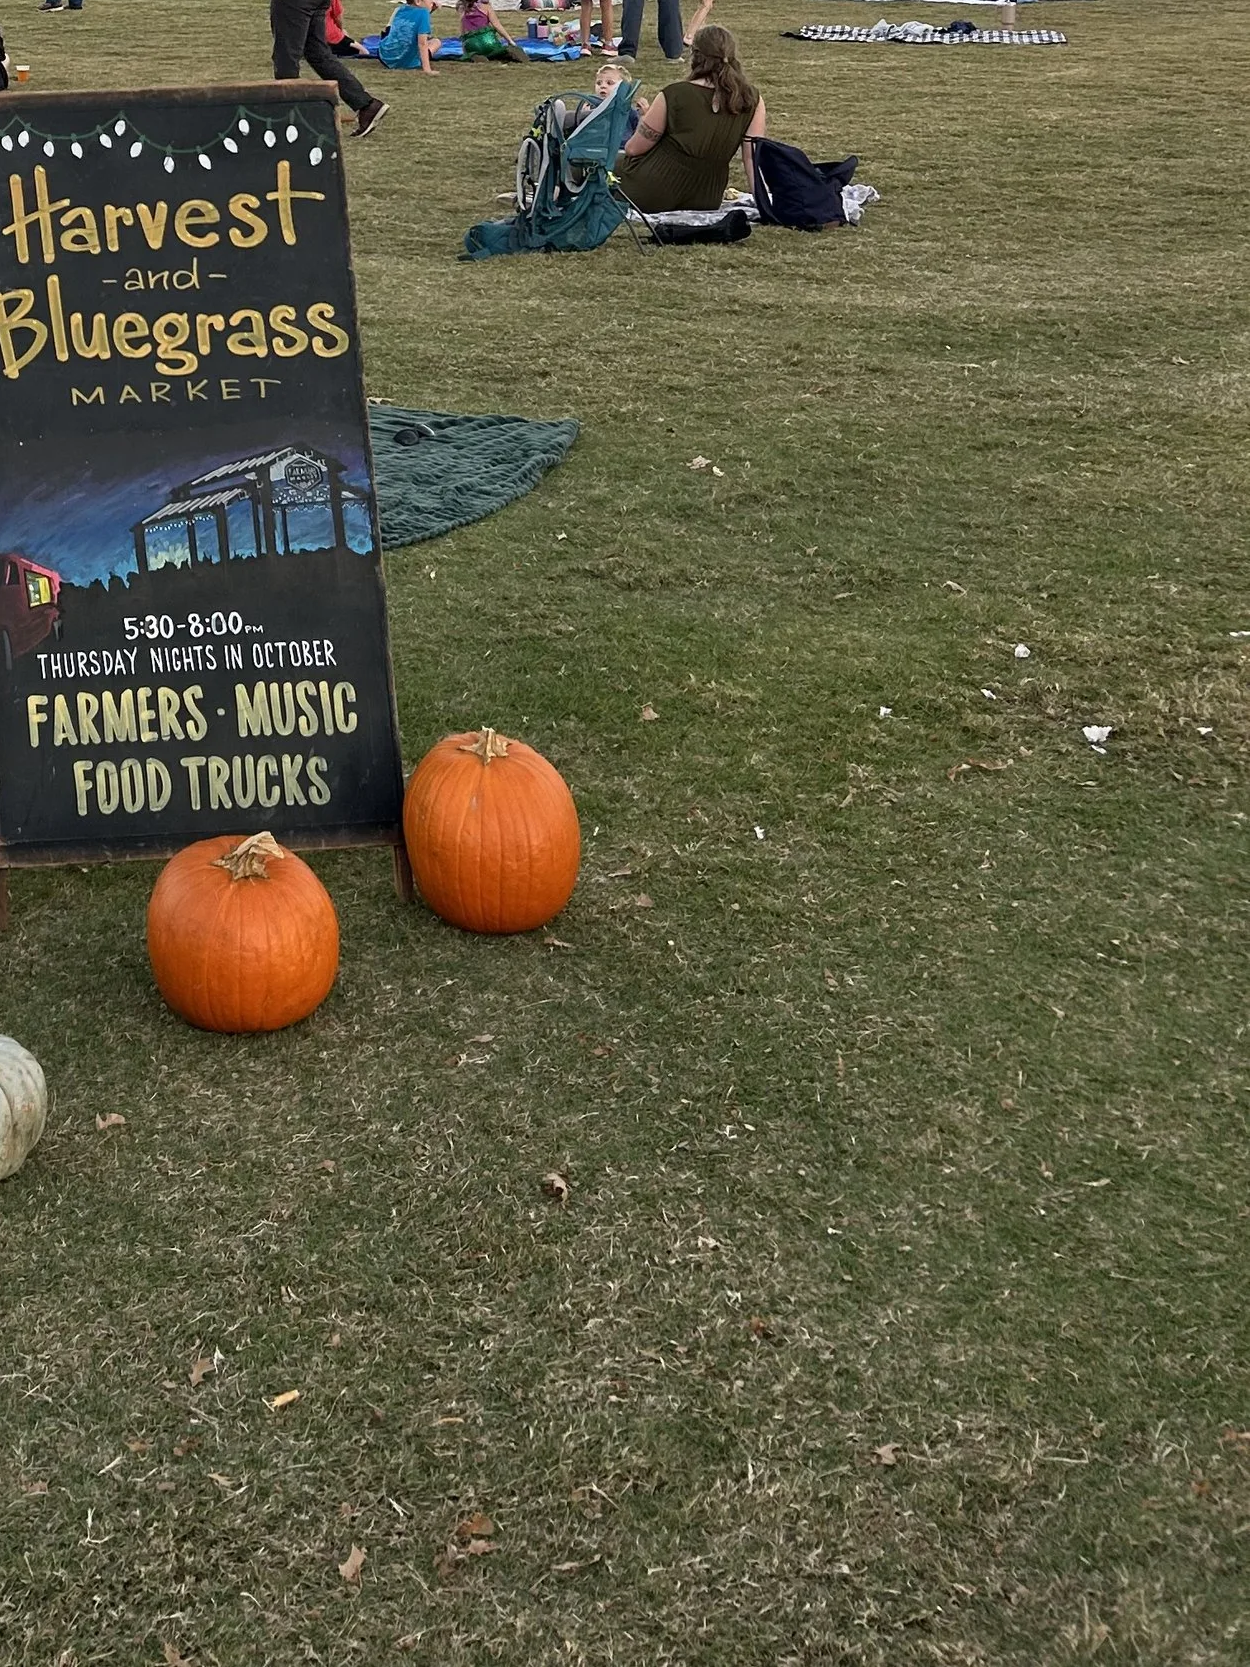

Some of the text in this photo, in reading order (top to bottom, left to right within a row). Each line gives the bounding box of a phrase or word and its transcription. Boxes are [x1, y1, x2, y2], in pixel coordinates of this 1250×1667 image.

[2, 159, 325, 264] Harvest
[70, 377, 282, 406] MARKET
[36, 639, 338, 680] THURSDAY NIGHTS IN OCTOBER
[26, 680, 358, 748] FARMERS MUSIC
[72, 753, 332, 816] FOOD TRUCKS
